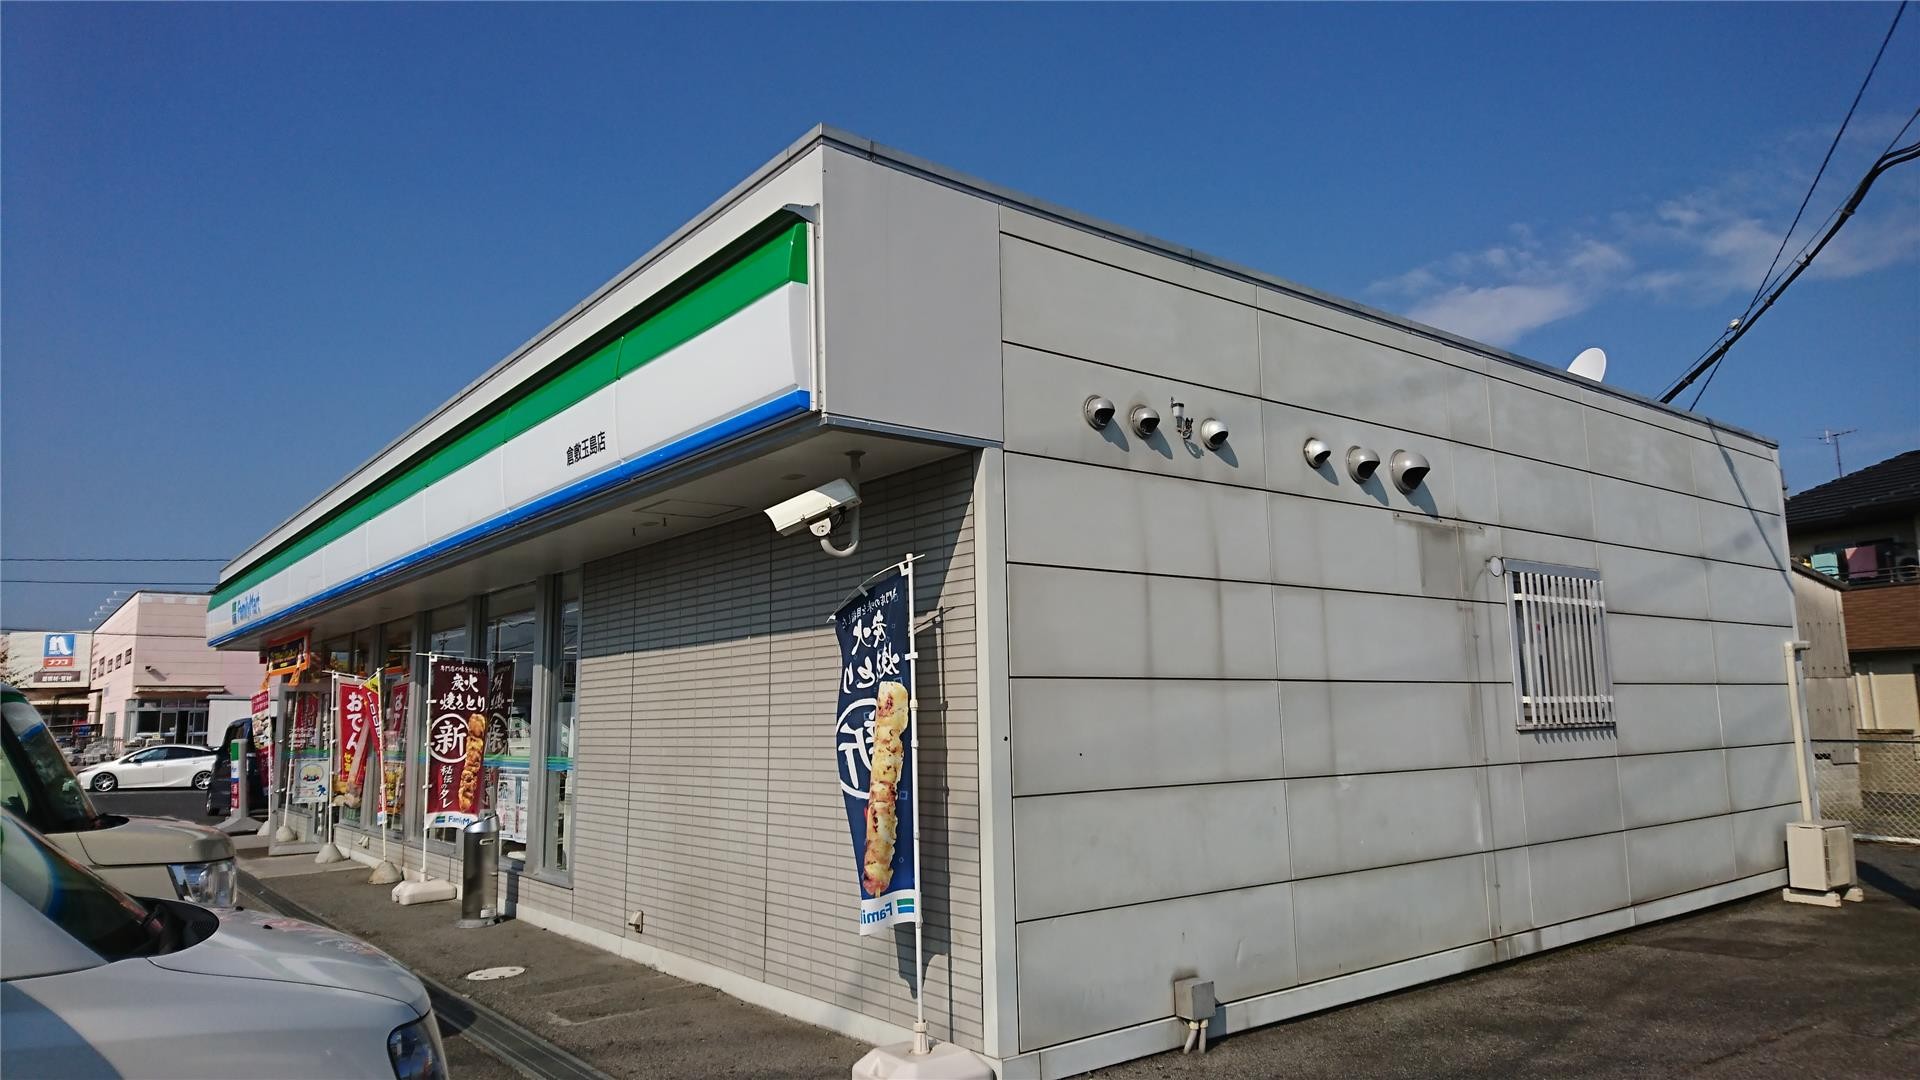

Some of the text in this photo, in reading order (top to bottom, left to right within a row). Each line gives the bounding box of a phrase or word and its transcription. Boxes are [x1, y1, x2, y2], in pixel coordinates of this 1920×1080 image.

[566, 430, 606, 466] 倉敷玉島店
[47, 658, 70, 666] ナフコ
[452, 674, 479, 693] 炭火
[440, 692, 486, 712] 焼きとり
[434, 719, 467, 757] 新
[439, 765, 454, 808] 秘伝のタレ
